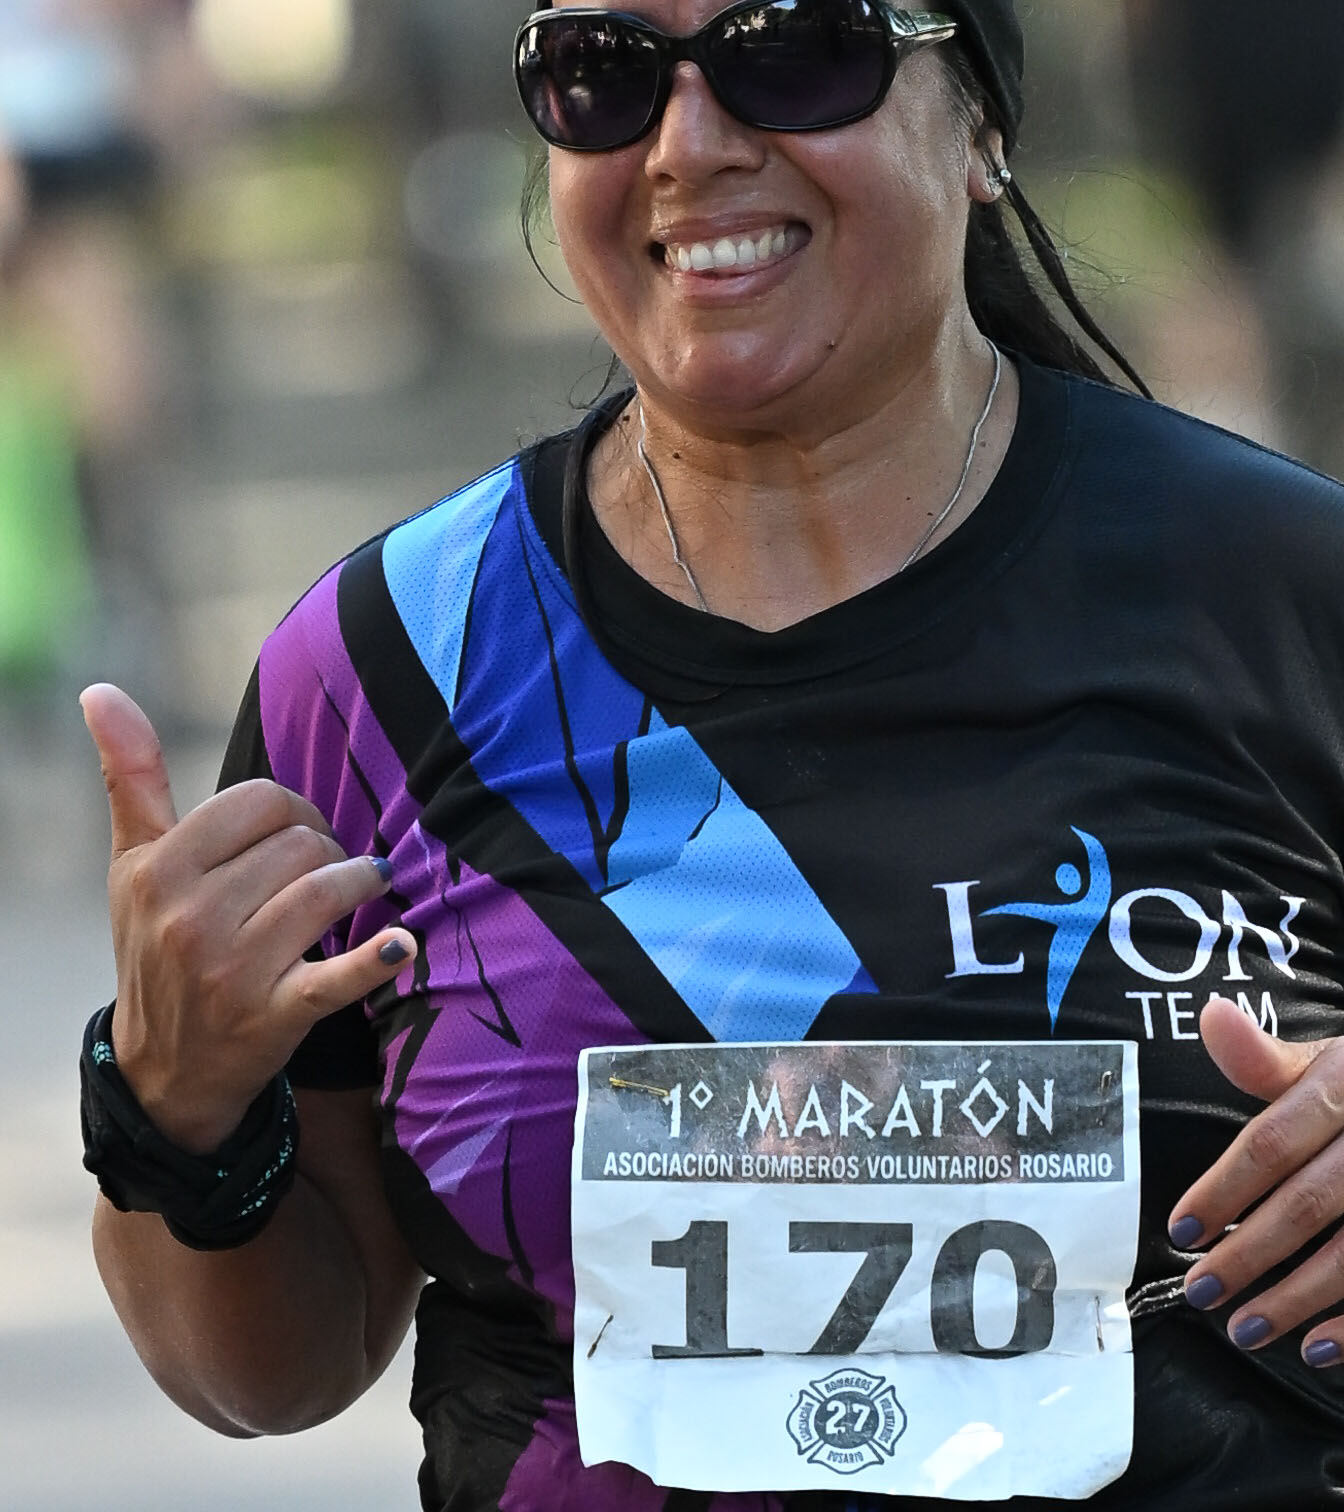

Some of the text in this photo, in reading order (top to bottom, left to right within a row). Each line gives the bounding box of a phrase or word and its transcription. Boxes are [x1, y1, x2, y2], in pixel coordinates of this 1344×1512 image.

[1124, 991, 1279, 1040] TEM
[736, 1059, 1055, 1139] MARATÓN
[603, 1148, 1114, 1180] ASOCIACIÓN BOMBEROS VOLUNTARIOS ROSARIO
[651, 1218, 1058, 1360] 170
[825, 1399, 871, 1435] 27
